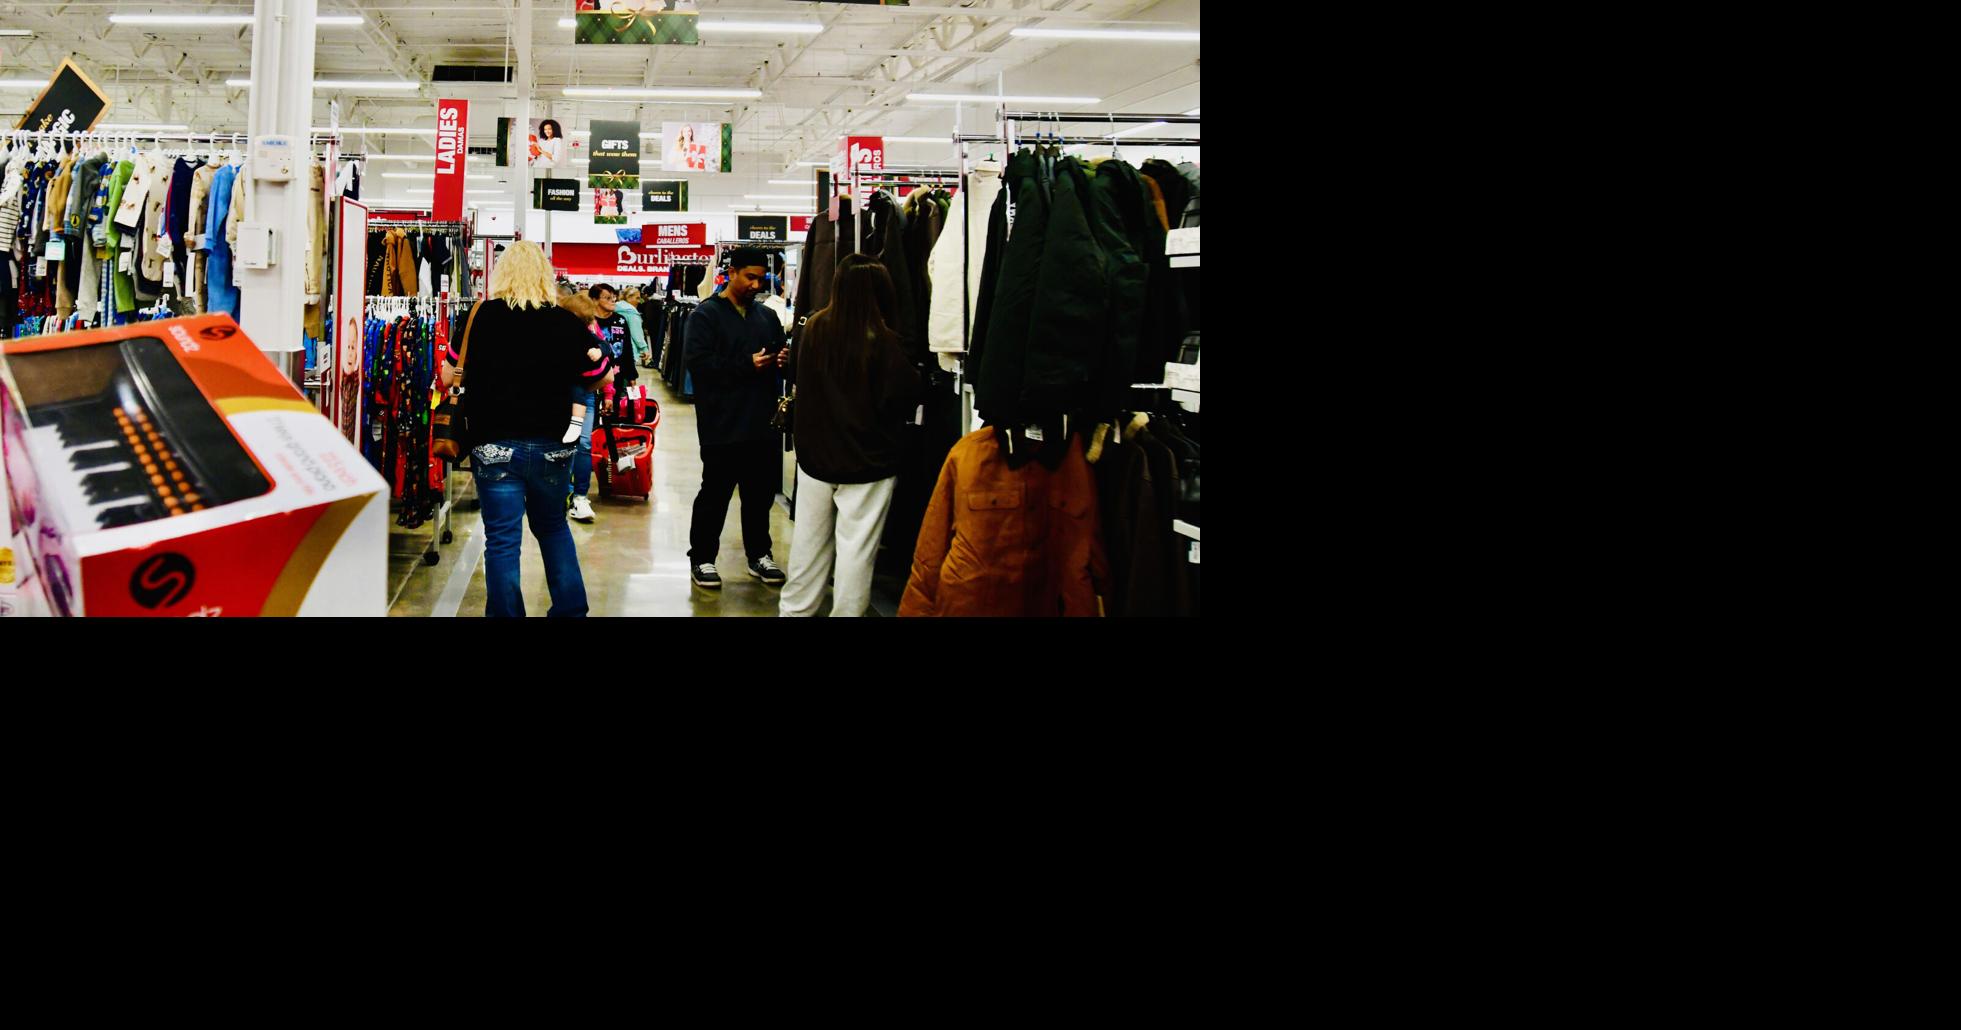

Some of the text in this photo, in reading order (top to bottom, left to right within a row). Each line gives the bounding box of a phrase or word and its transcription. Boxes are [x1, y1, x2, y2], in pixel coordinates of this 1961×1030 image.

[437, 108, 458, 175] LADIES
[457, 127, 465, 154] DAMAS
[601, 139, 629, 150] GIFTS
[547, 188, 575, 196] FASHION
[658, 225, 688, 237] MENS
[749, 231, 776, 240] DEALS
[656, 237, 690, 245] CABALLEROS
[646, 265, 670, 273] BRAN
